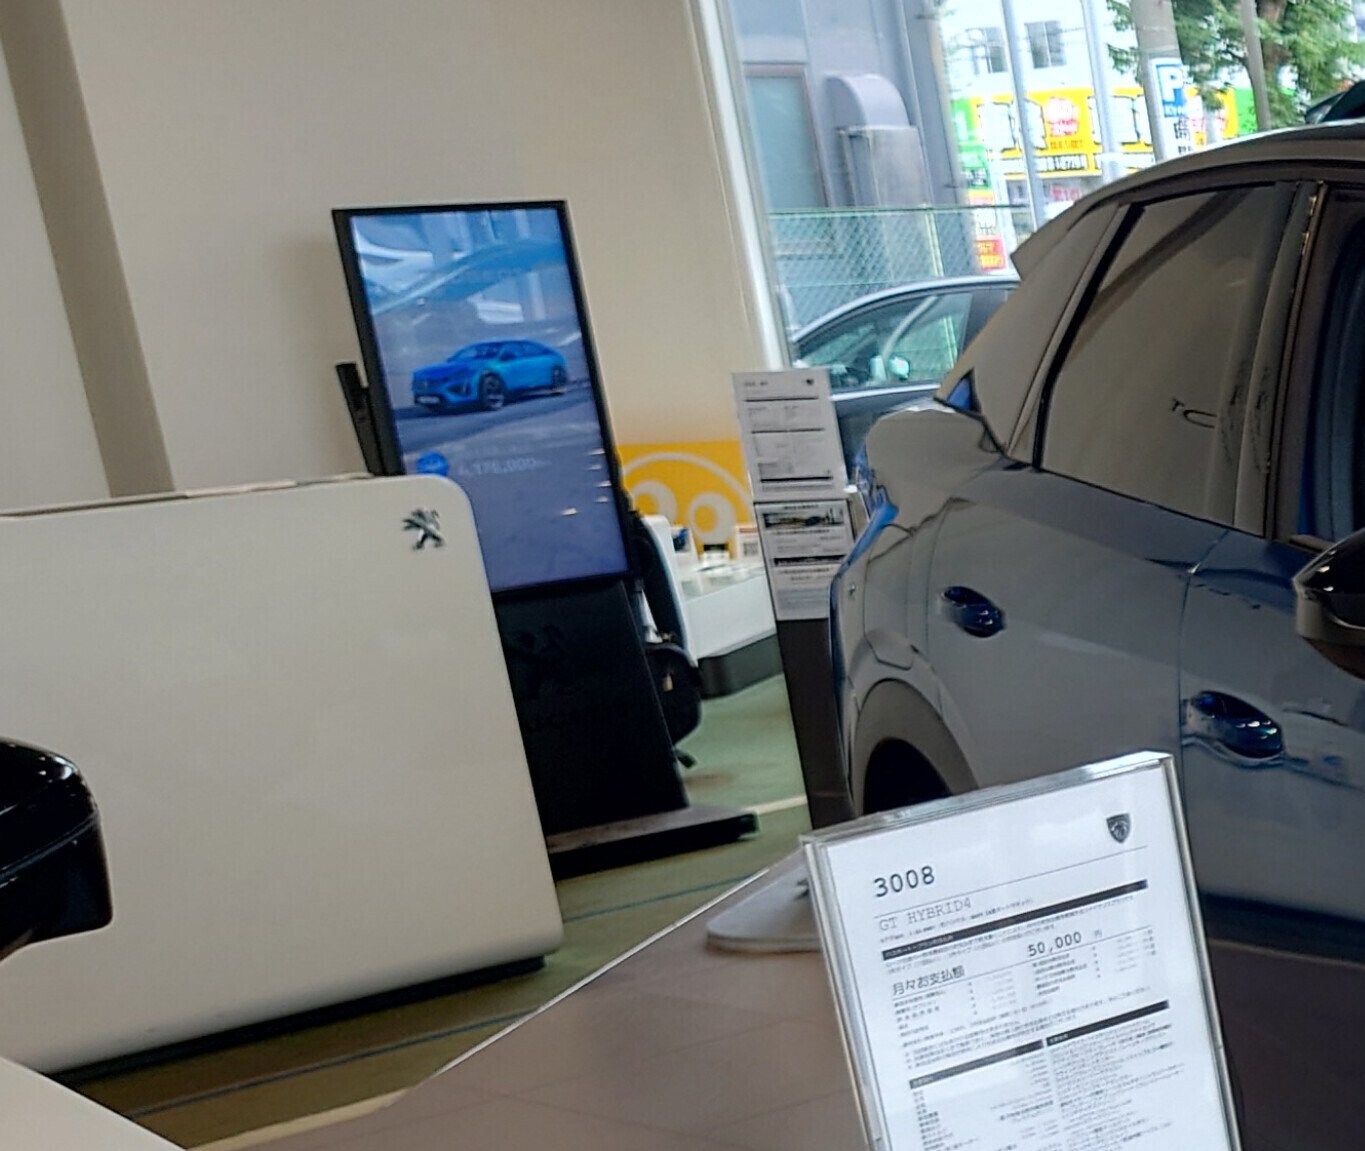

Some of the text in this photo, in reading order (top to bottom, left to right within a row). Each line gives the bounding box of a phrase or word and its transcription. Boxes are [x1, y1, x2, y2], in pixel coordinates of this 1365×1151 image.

[1158, 66, 1184, 101] P
[874, 866, 936, 898] 3008
[879, 916, 898, 932] GT
[907, 898, 972, 924] HYBRID4
[1028, 931, 1082, 957] 50,000
